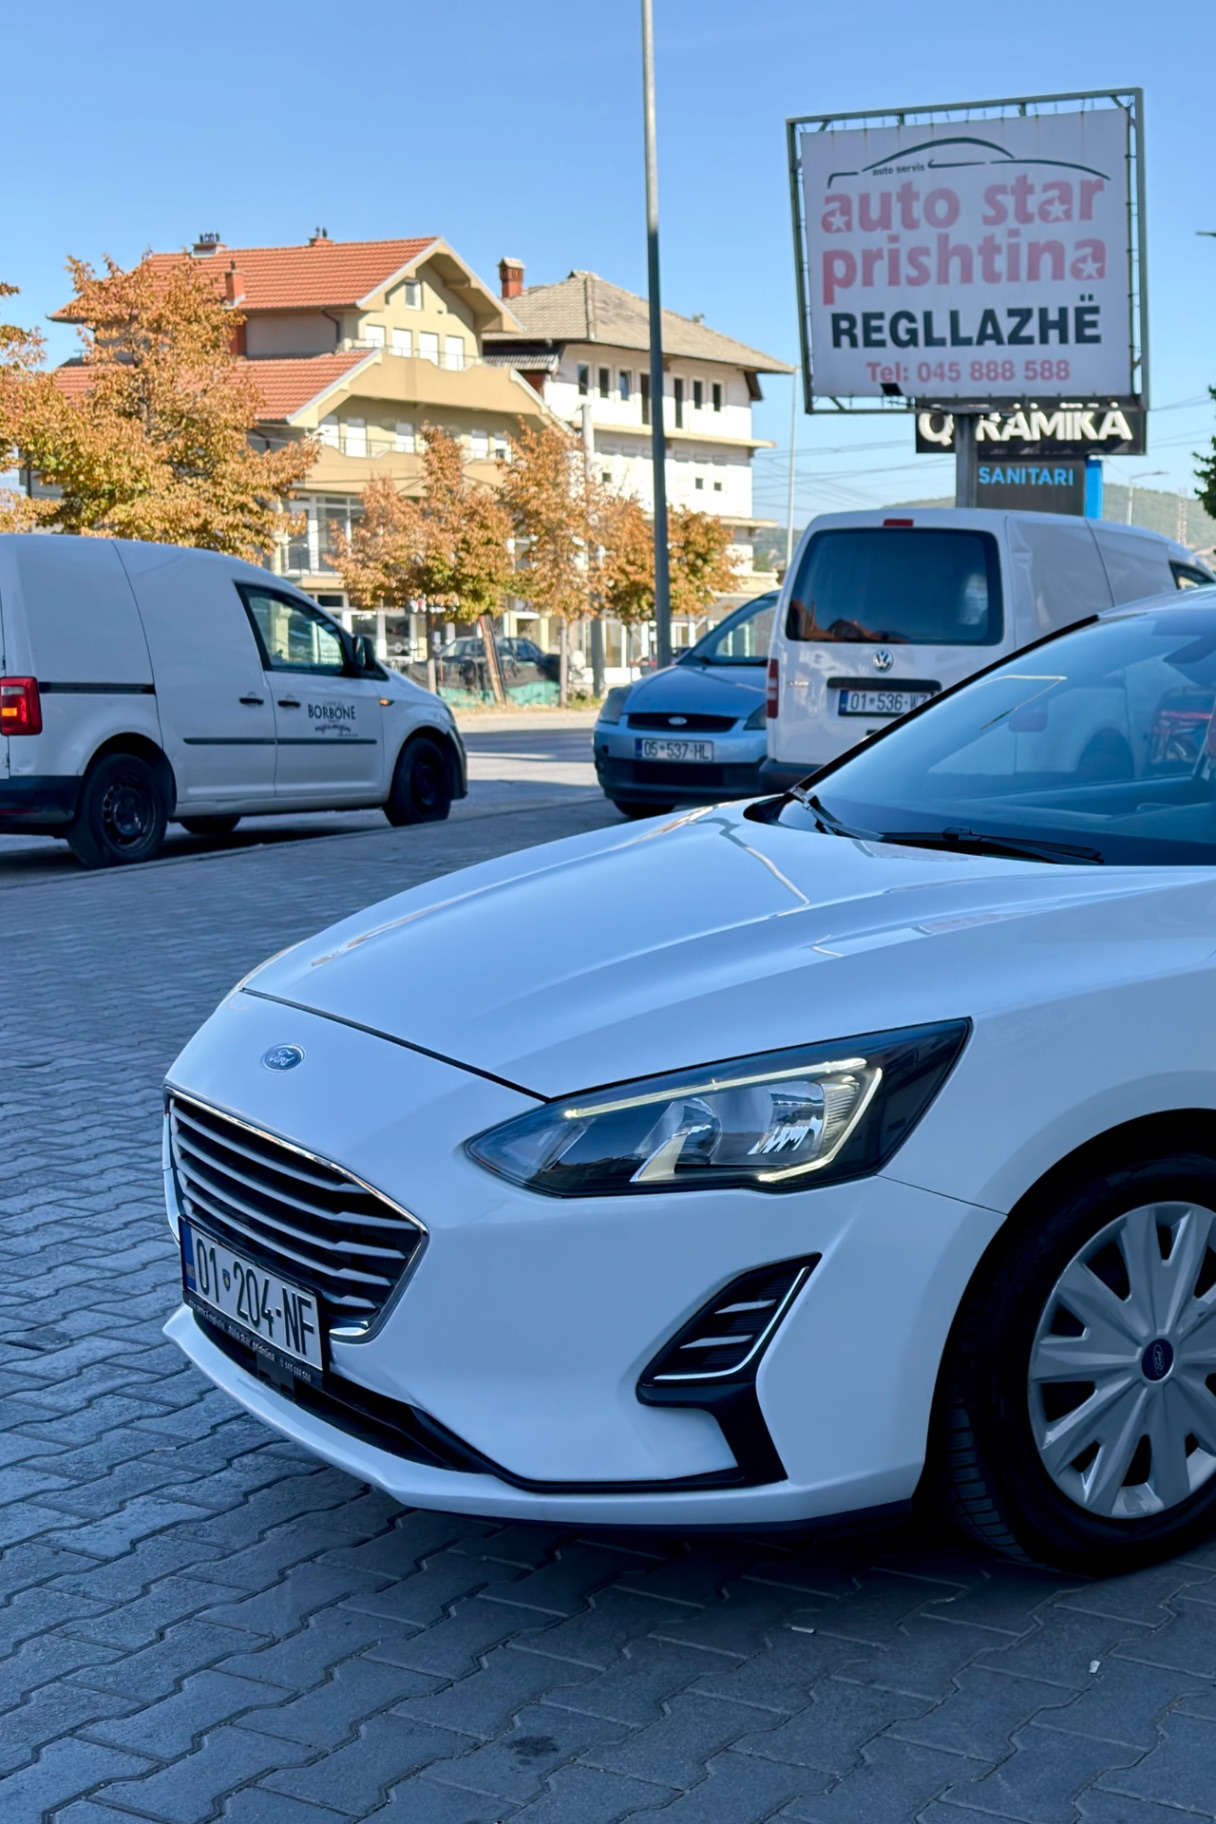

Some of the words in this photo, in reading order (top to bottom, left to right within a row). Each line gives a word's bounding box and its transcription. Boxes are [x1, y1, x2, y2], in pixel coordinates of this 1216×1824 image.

[820, 181, 961, 234] auto
[982, 174, 1105, 226] star
[822, 228, 1107, 305] prishtina
[831, 294, 1102, 348] REGLLAZHË
[866, 361, 909, 382] Tel:
[917, 361, 962, 382] 045
[970, 360, 1015, 382] 888
[1023, 359, 1070, 381] 588
[918, 402, 1133, 446] QRAMIKA
[978, 466, 1074, 486] SANITARI
[308, 704, 356, 720] BORBONE
